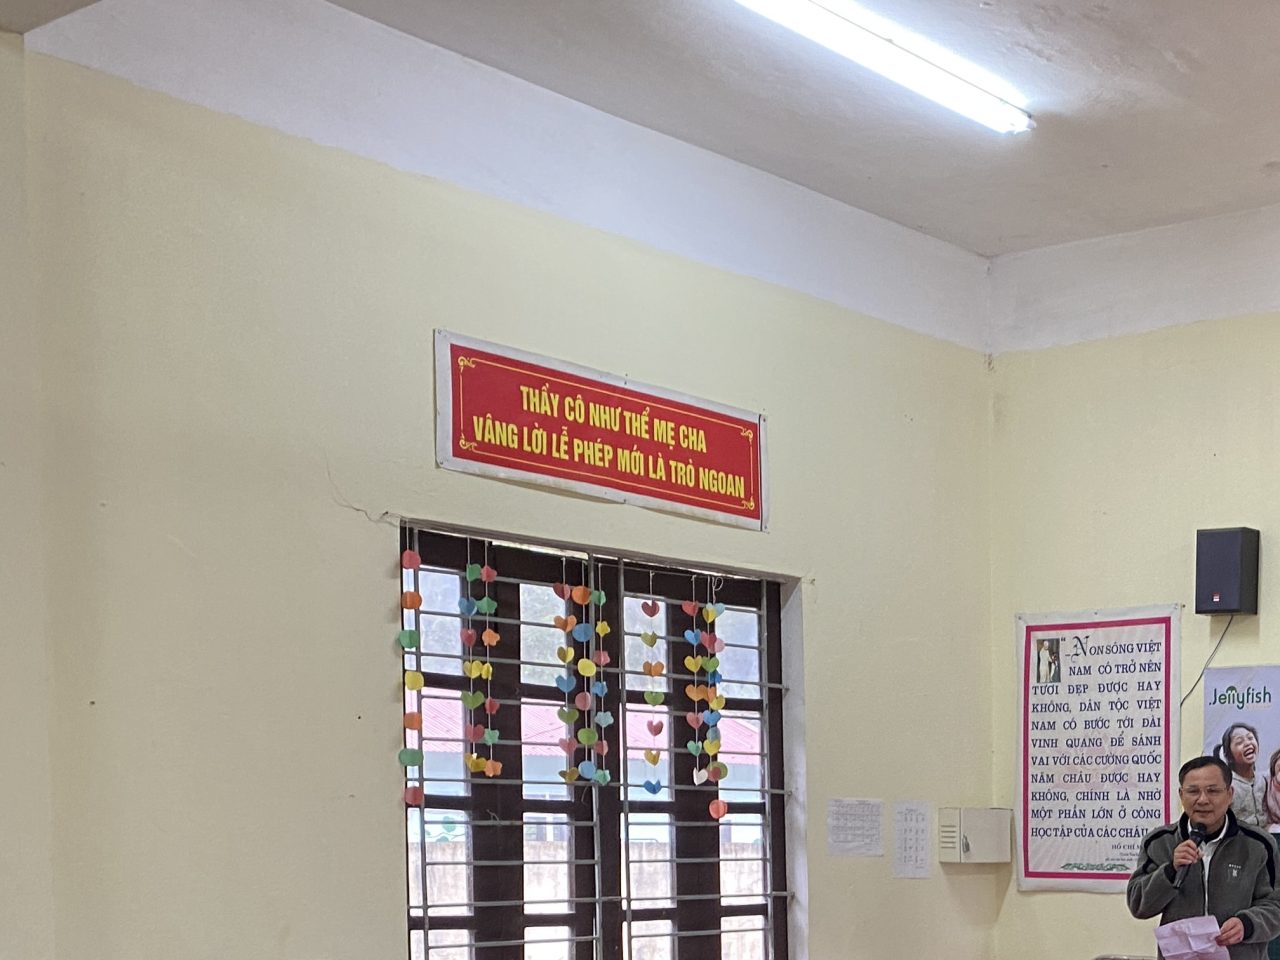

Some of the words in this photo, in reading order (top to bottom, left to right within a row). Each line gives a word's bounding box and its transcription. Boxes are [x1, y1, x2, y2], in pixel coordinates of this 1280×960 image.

[520, 382, 560, 417] THẦY
[565, 395, 585, 423] CÔ
[589, 403, 623, 431] NHƯ
[624, 406, 650, 439] THỂ
[653, 420, 675, 448] MẸ
[679, 427, 707, 453] CHA
[473, 413, 518, 448] VÂNG
[523, 423, 547, 456] LỜI
[552, 426, 569, 460] LỄ
[574, 434, 613, 468] PHÉP
[617, 445, 644, 476] MỚI
[648, 451, 666, 480] LÀ
[669, 459, 695, 487] TRÒ
[699, 471, 745, 499] NGOAN
[1136, 640, 1162, 655] VIỆT
[1069, 665, 1092, 676] NAM
[1098, 661, 1112, 675] CÓ
[1139, 660, 1162, 673] NÊN
[1032, 685, 1059, 696] TƯƠI
[1068, 684, 1089, 696] ĐẸP
[1137, 681, 1161, 691] HAY
[1136, 697, 1162, 711] VIỆT
[1209, 686, 1272, 710] Jellyfish
[1031, 721, 1056, 730] NAM
[1063, 717, 1077, 730] CÓ
[1031, 738, 1058, 748] VINH
[1065, 738, 1103, 748] QUANG
[1131, 733, 1161, 746] SÁNH
[1031, 756, 1049, 766] VAI
[1052, 753, 1070, 765] VỚI
[1073, 753, 1093, 765] CÁC
[1137, 772, 1161, 783] HAY
[1075, 789, 1110, 800] CHÍNH
[1117, 788, 1130, 800] LÀ
[1031, 806, 1053, 821] MỘT
[1092, 806, 1113, 819] LỚN
[1031, 827, 1052, 839] HỌC
[1053, 825, 1073, 839] TẬP
[1074, 824, 1094, 837] CỦA
[1096, 824, 1117, 837] CÁC
